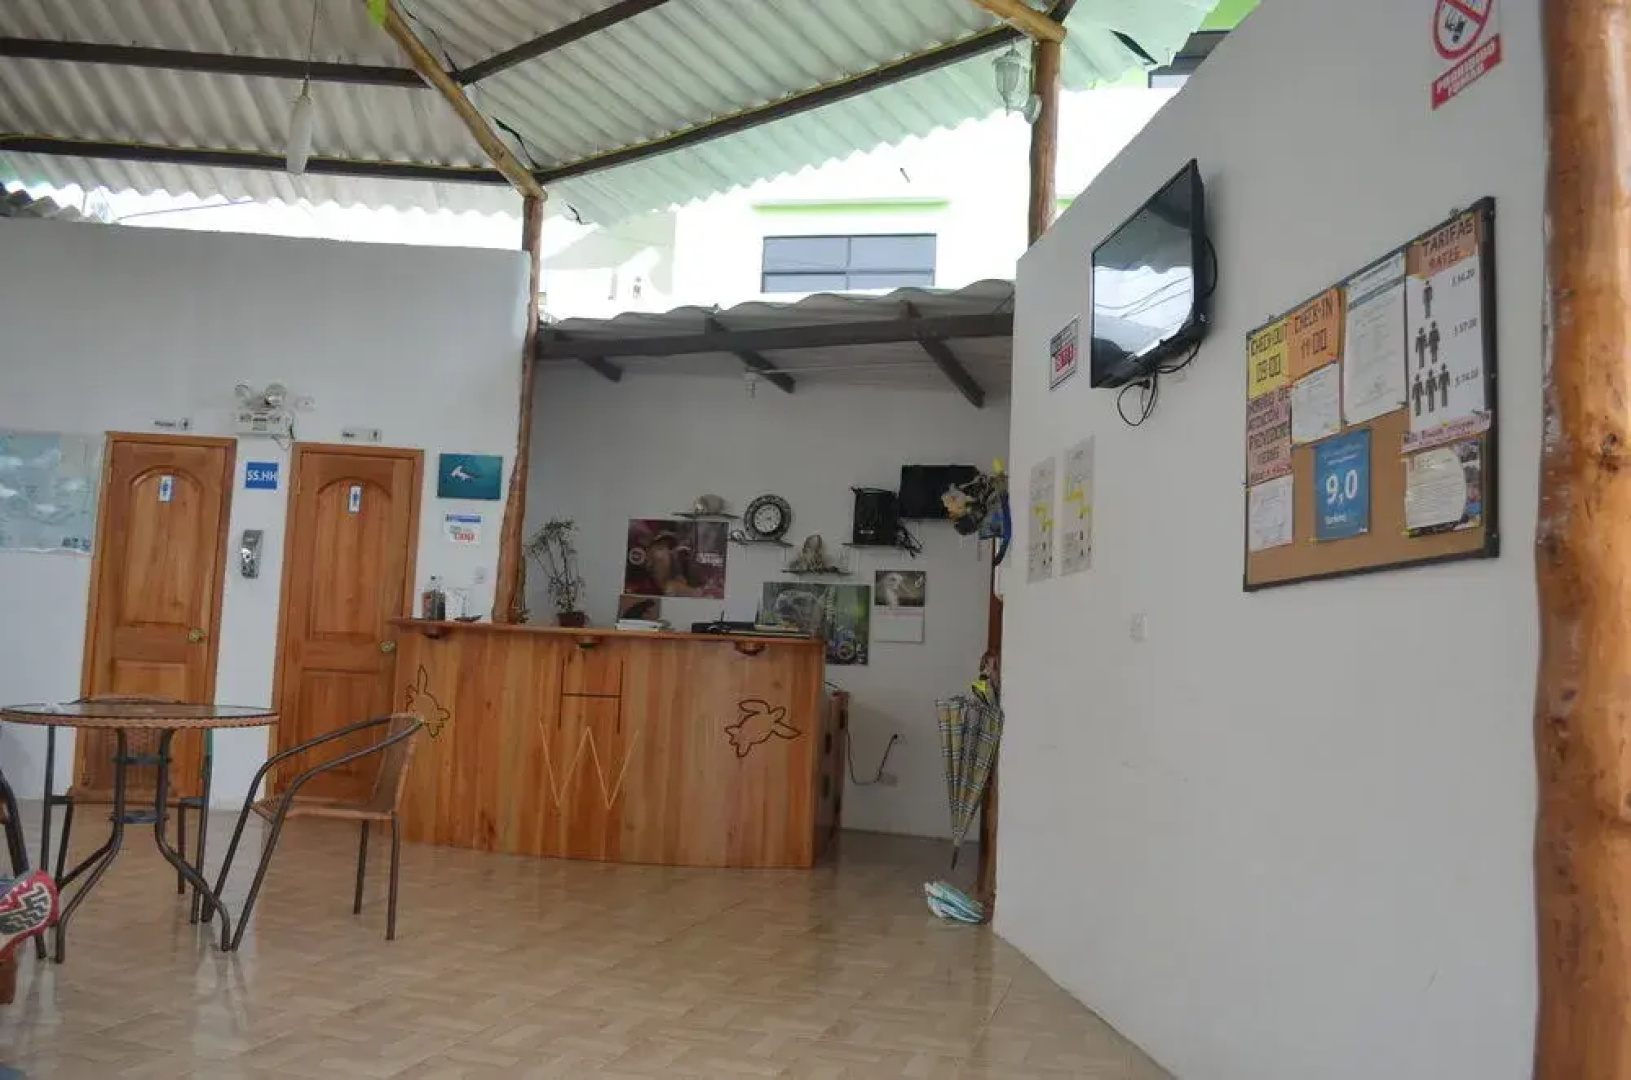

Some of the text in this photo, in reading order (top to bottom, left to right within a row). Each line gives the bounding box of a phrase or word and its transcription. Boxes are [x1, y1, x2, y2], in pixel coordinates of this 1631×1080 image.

[1422, 219, 1474, 257] TARIFAS
[1294, 297, 1333, 334] CHECK-IN
[247, 469, 277, 482] SS.HH
[1325, 469, 1358, 505] 9,0
